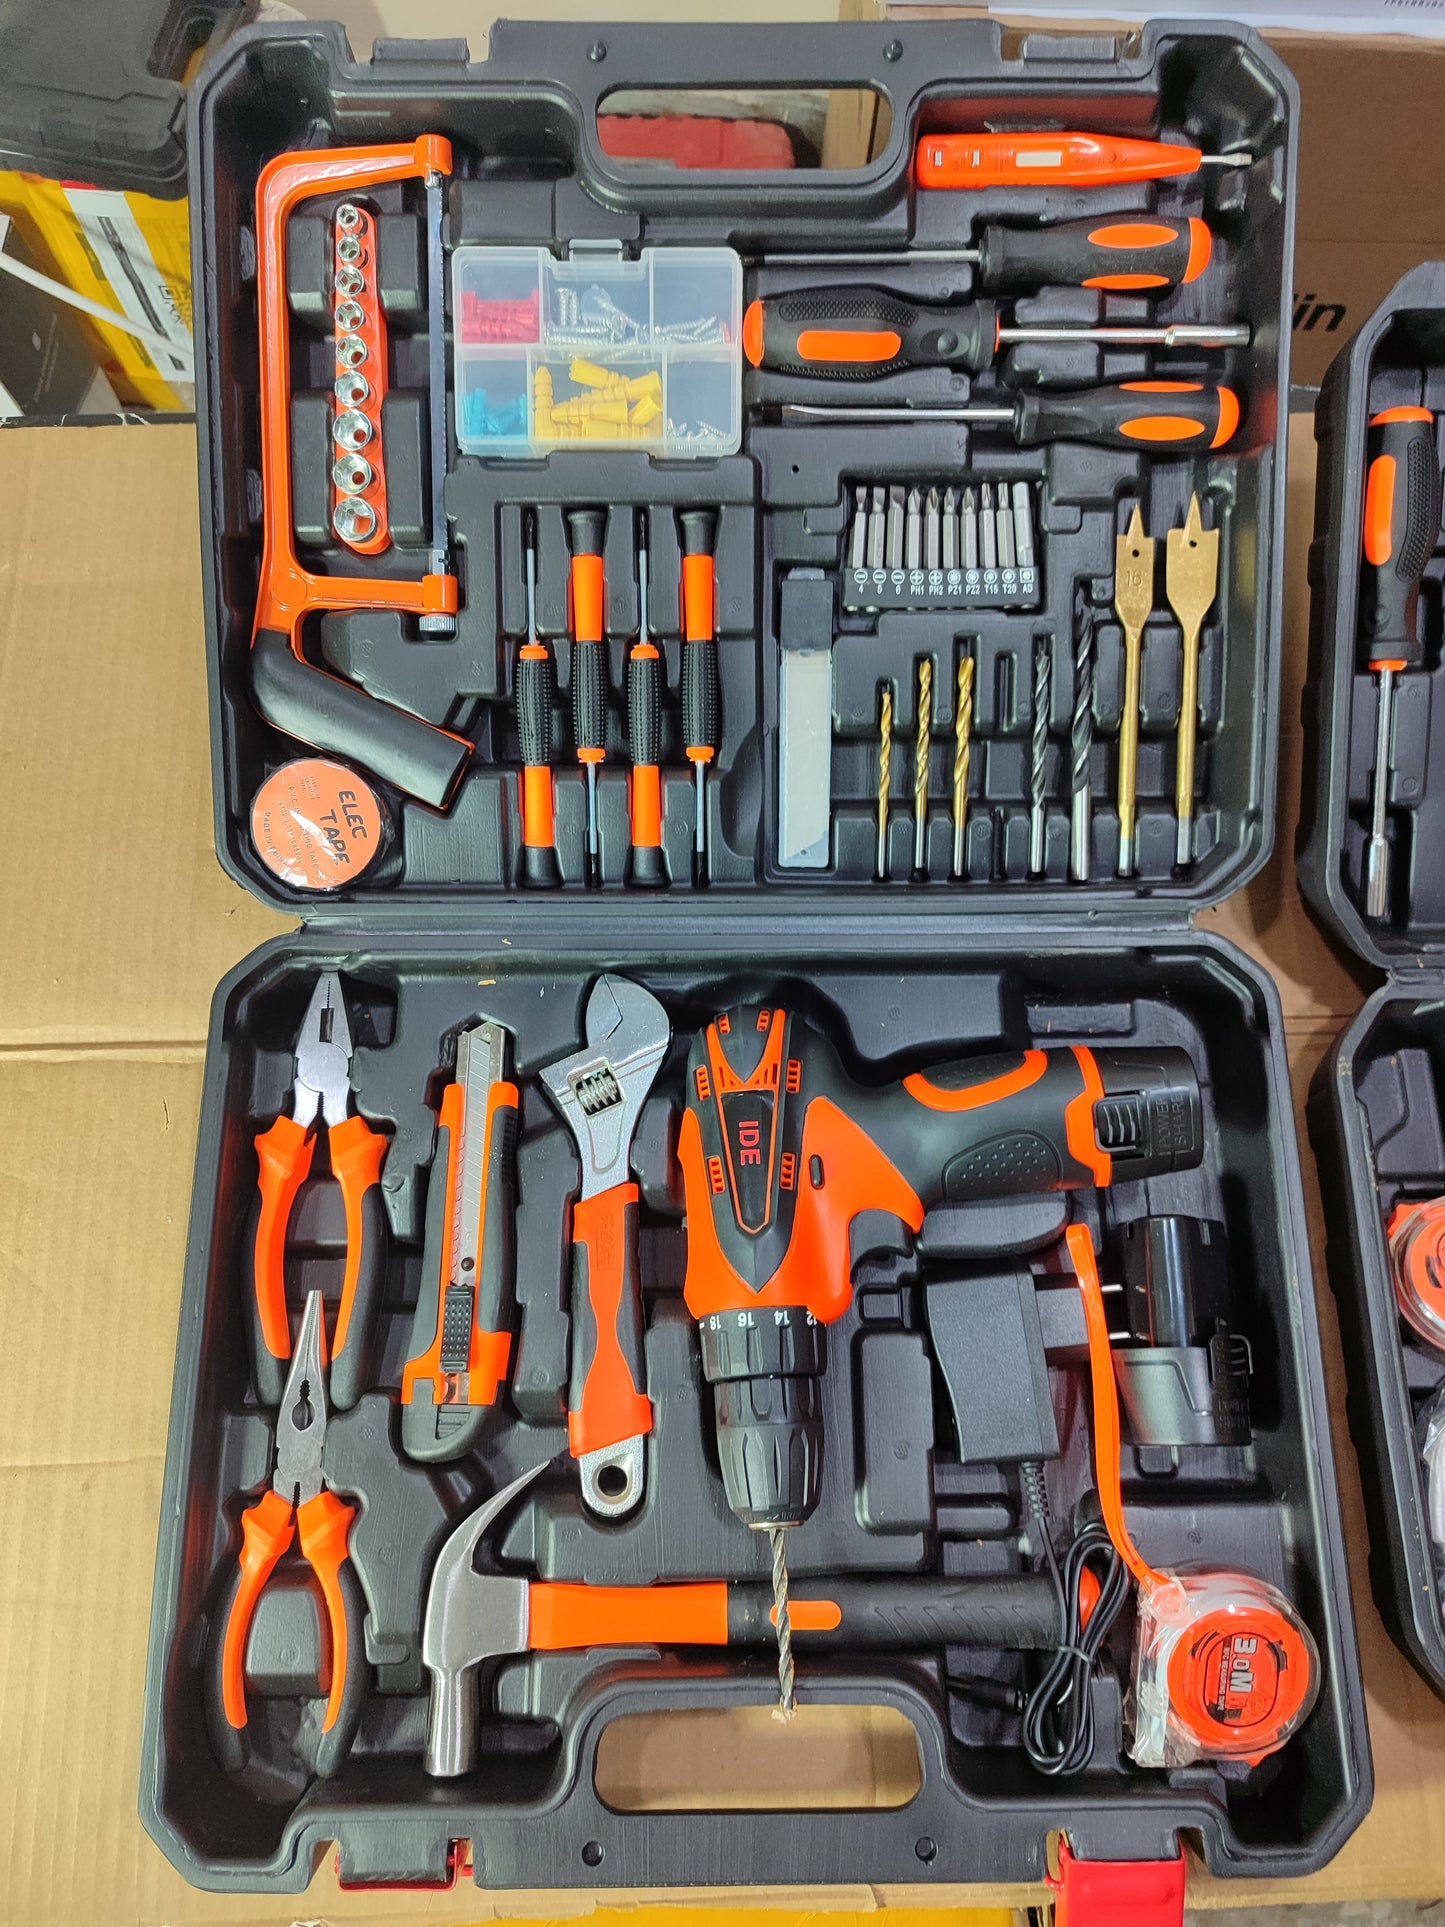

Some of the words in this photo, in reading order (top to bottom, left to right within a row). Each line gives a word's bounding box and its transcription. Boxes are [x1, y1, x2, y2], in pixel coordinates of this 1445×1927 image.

[1293, 293, 1346, 331] in
[858, 584, 864, 595] 4
[895, 585, 902, 595] 6
[910, 585, 925, 596] PH1
[928, 585, 944, 596] PH2
[947, 585, 962, 595] PZ1
[965, 585, 981, 595] PZ2
[984, 584, 999, 595] T15
[1002, 584, 1017, 595] T20
[1022, 584, 1033, 594] AD
[338, 790, 368, 839] ELEC
[320, 808, 351, 866] TAPE
[738, 1120, 761, 1166] IDE
[710, 1314, 722, 1330] 18
[737, 1311, 755, 1327] 16
[774, 1310, 790, 1326] 14
